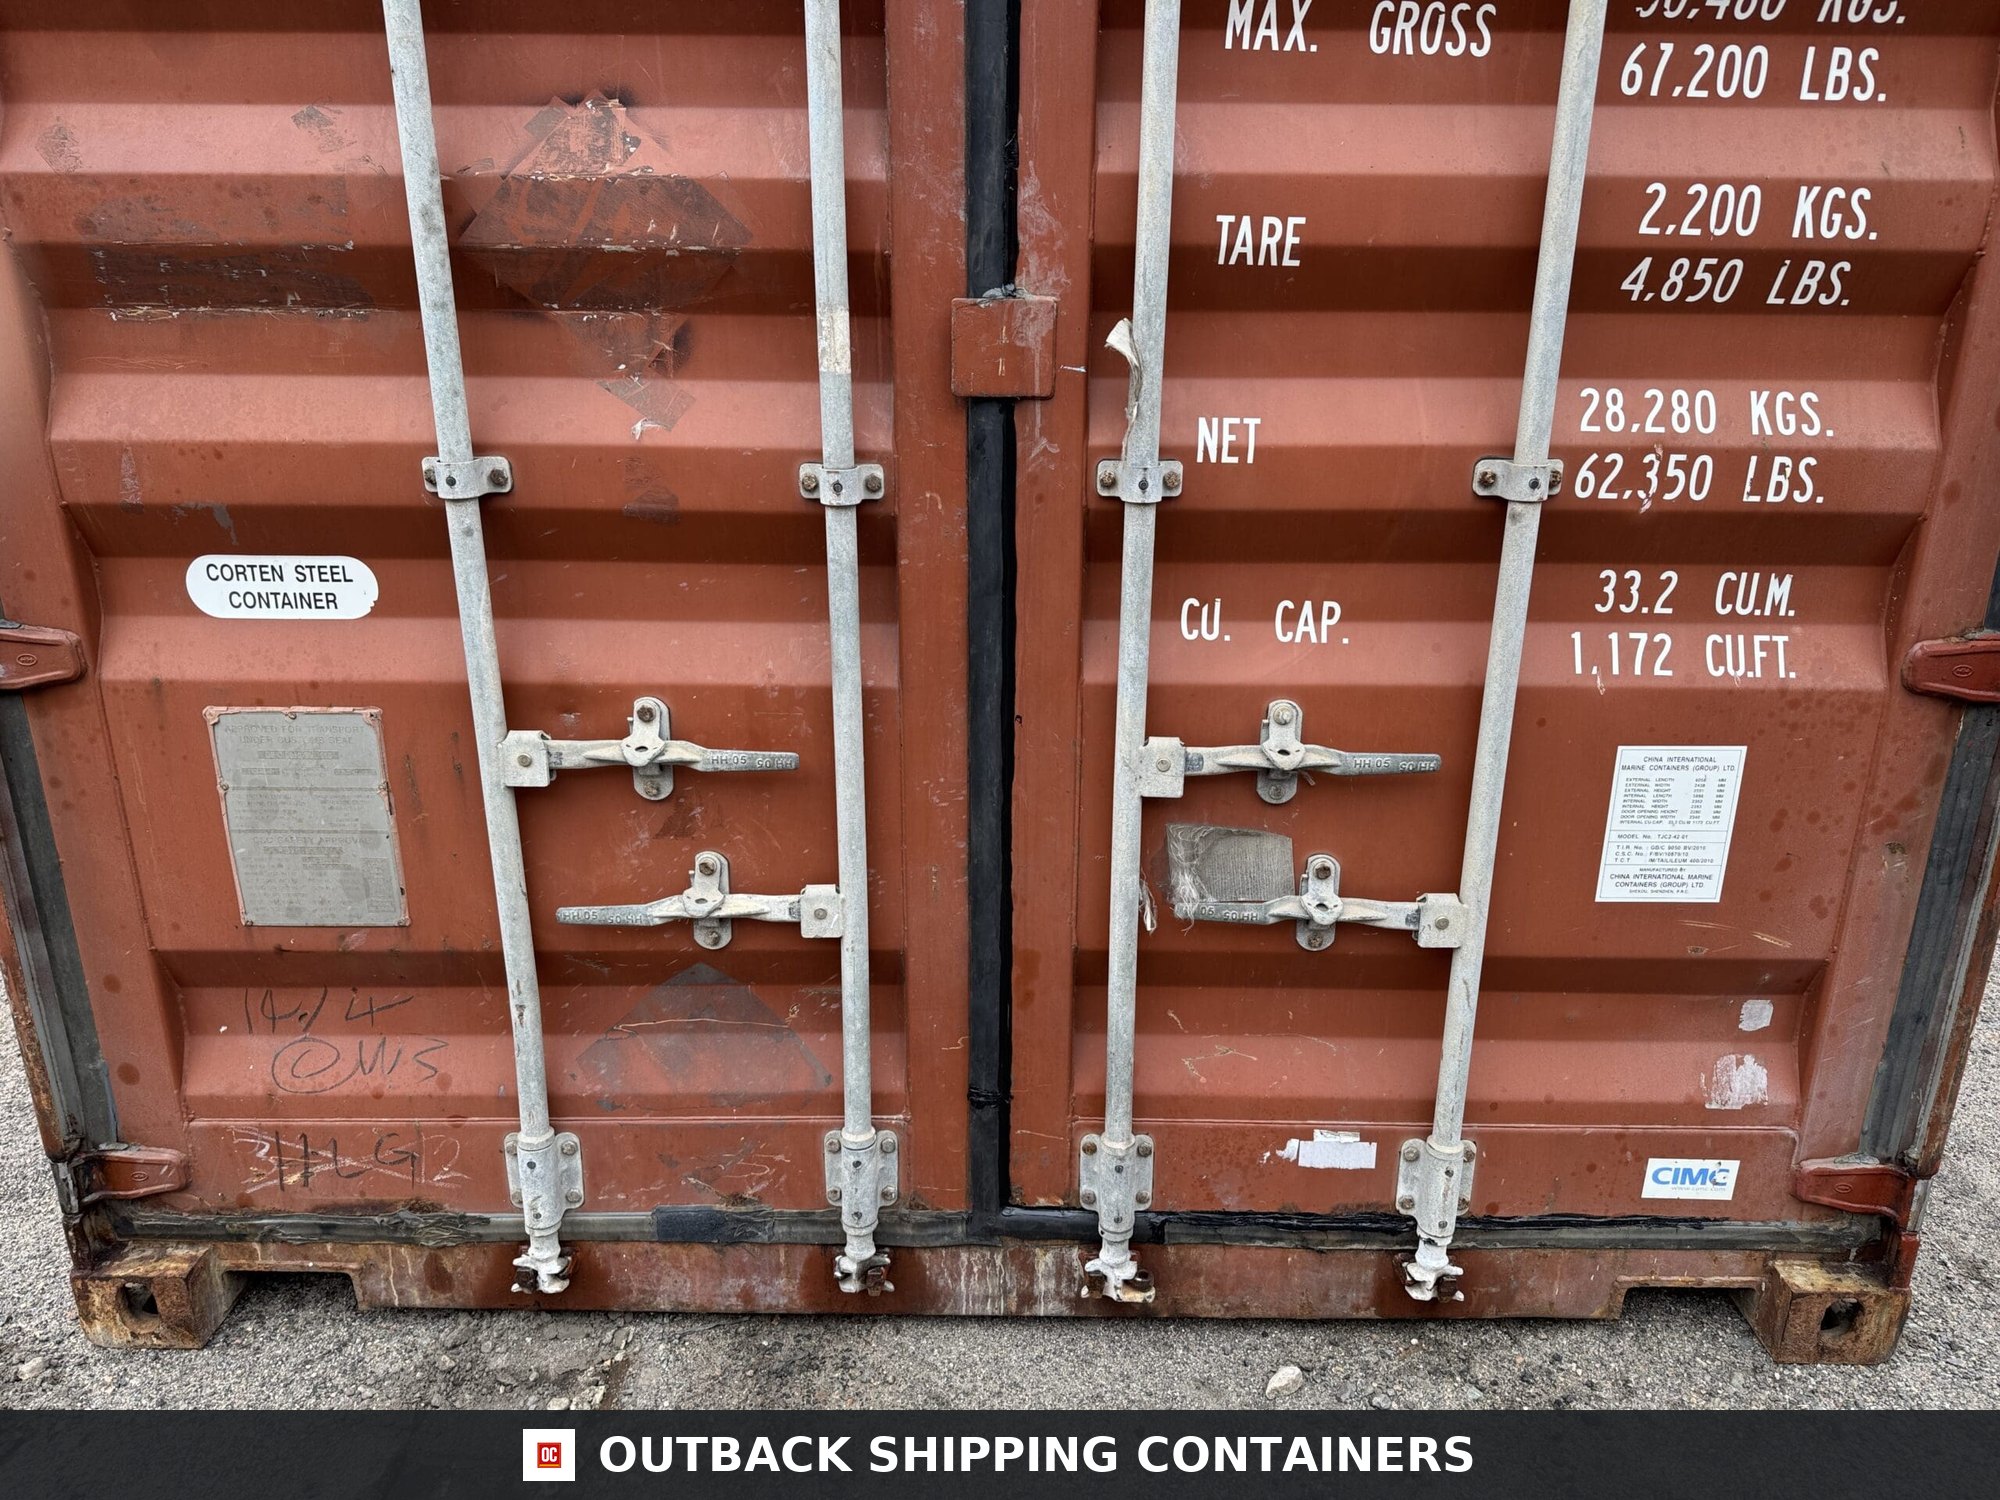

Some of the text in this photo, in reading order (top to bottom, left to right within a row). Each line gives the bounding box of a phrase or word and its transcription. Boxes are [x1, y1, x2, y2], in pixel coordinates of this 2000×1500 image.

[1225, 0, 1496, 57] MAX. GROSS
[1621, 43, 1886, 102] 67,200 LBS.
[1639, 182, 1878, 240] 2,200 KGS.
[1216, 215, 1306, 267] TARE
[1620, 257, 1851, 305] 4,850 LBS.
[1580, 388, 1834, 436] 28,280 KGS.
[1197, 417, 1261, 464] NET
[1574, 453, 1824, 503] 62,350 LBS.
[206, 563, 353, 583] CORTEN STEEL
[1594, 569, 1795, 616] 33.2 CU.M.
[229, 591, 338, 609] CONTAINER
[1180, 598, 1349, 644] CU. CAP.
[1571, 631, 1796, 679] 1,172 CU.FT.
[1651, 1167, 1730, 1186] CIMC
